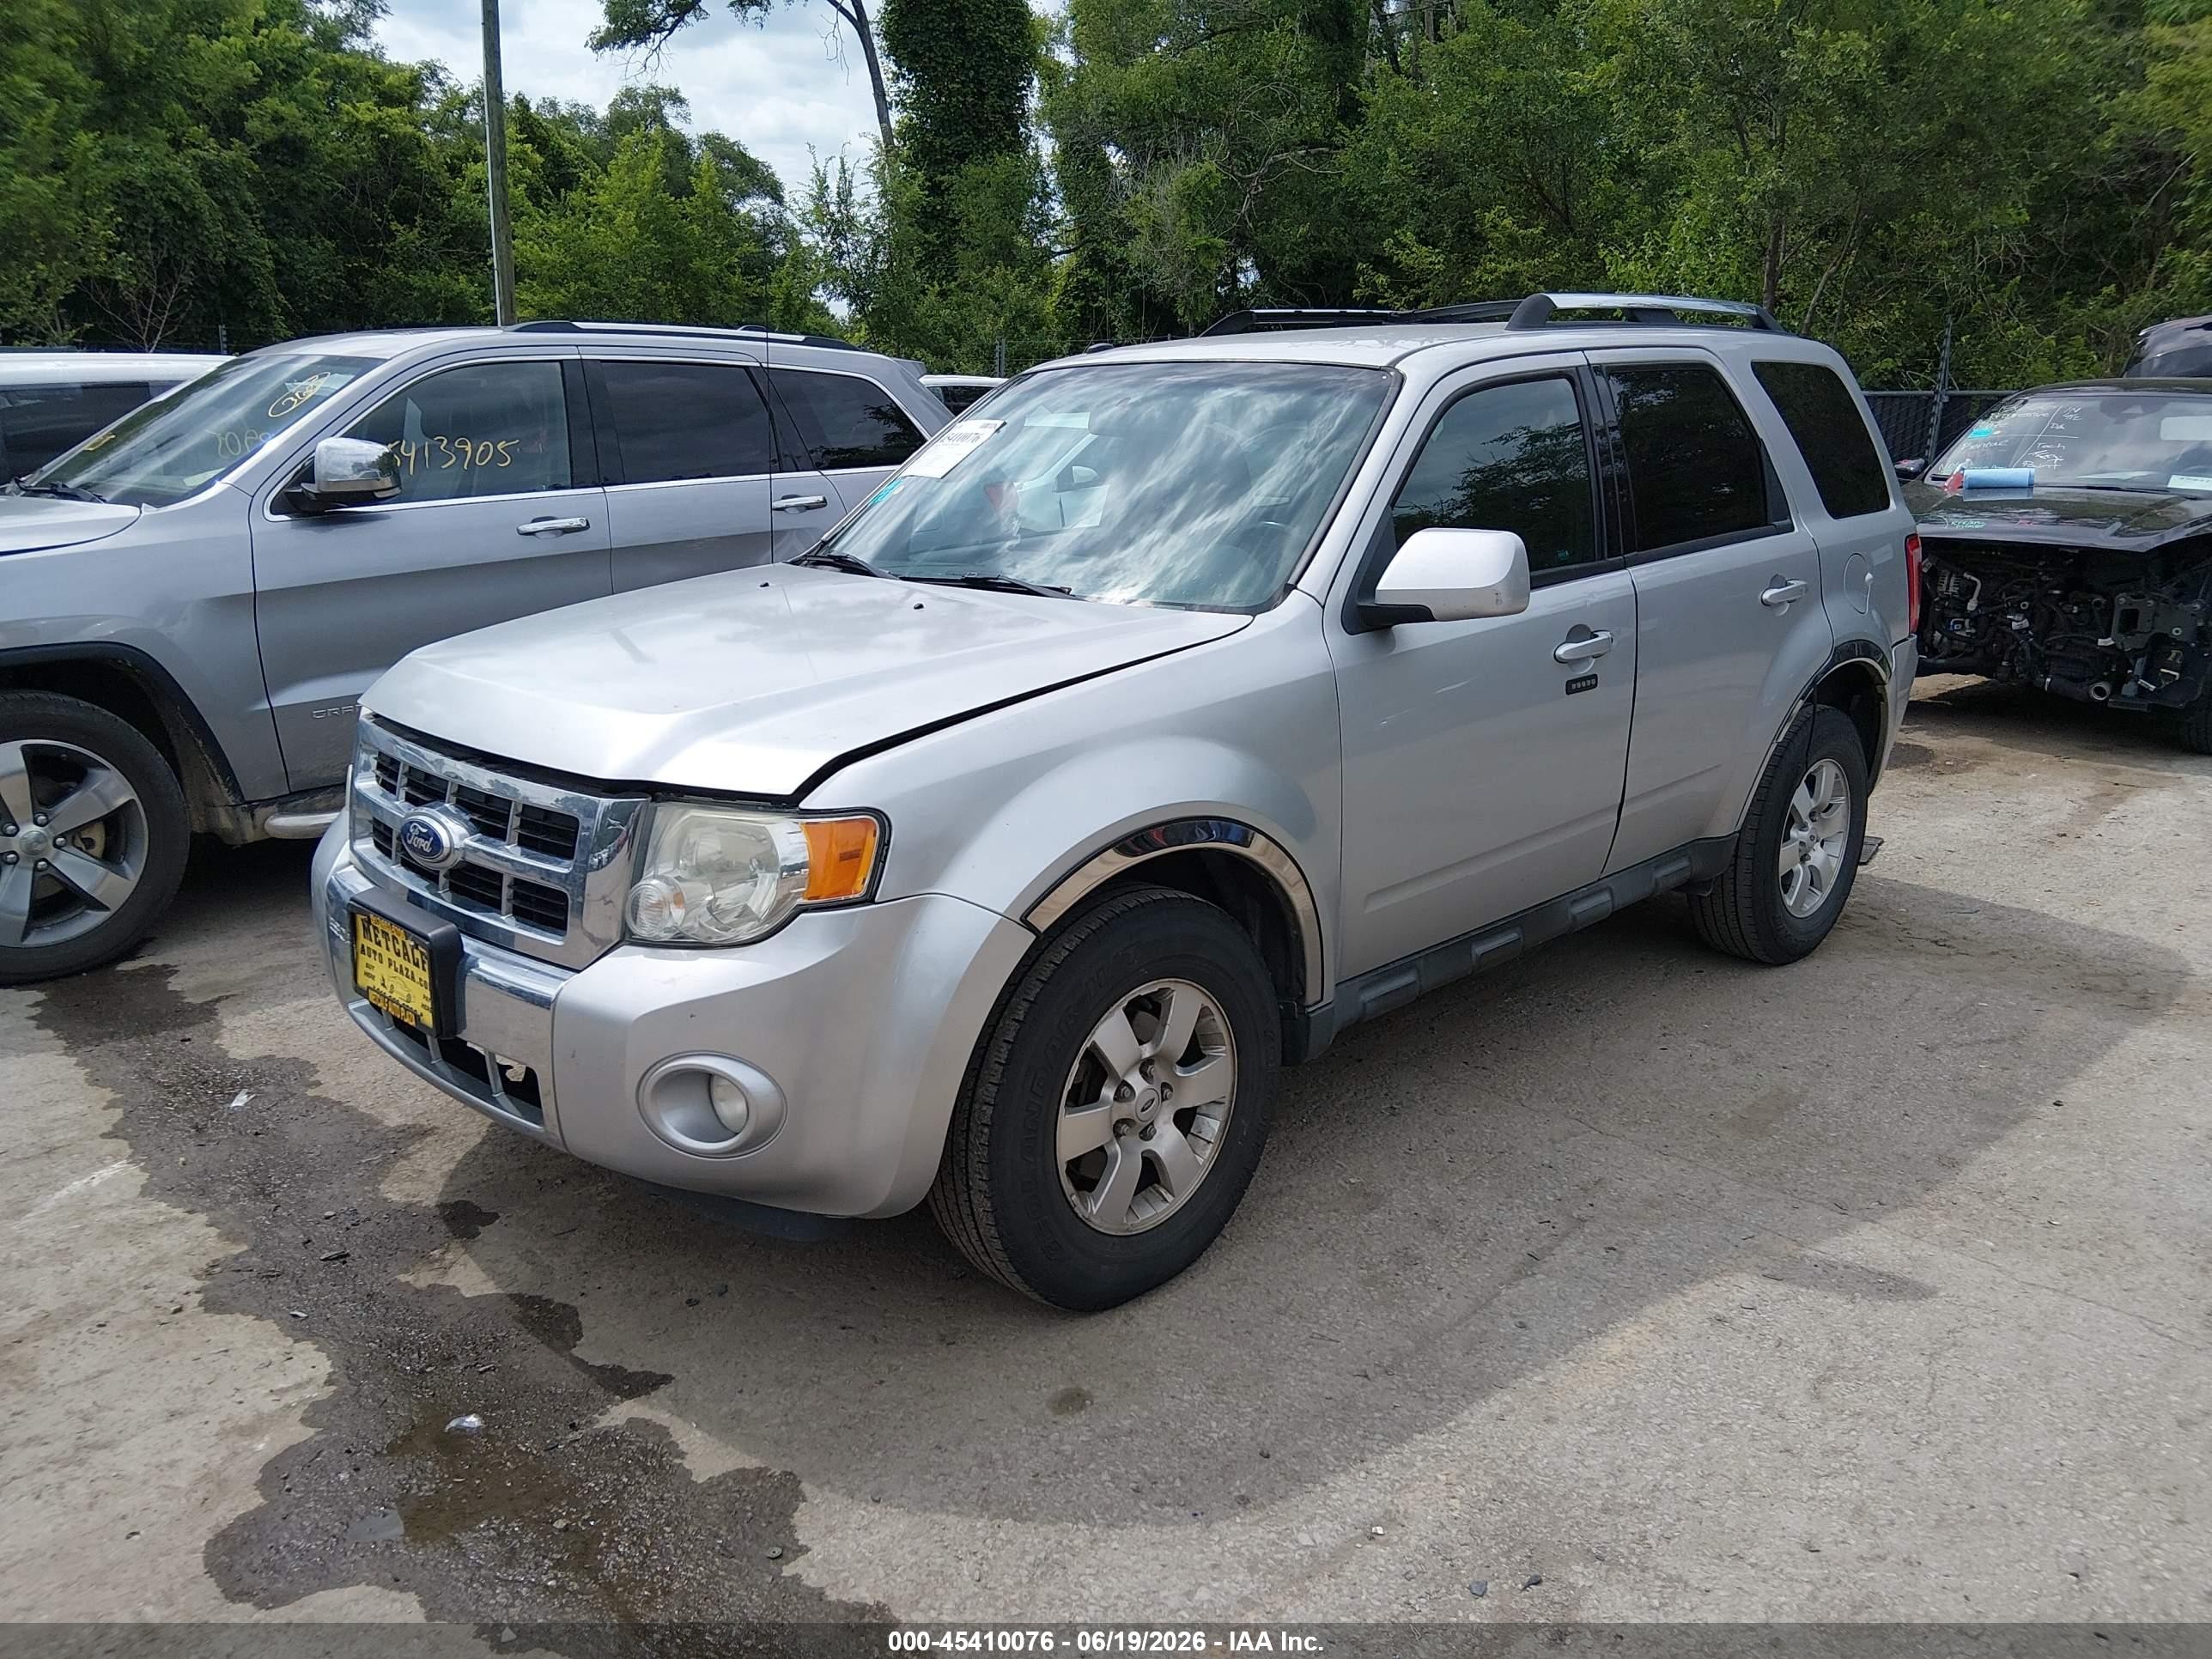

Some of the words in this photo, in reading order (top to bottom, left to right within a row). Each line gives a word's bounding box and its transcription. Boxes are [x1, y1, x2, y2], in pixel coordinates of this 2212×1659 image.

[387, 435, 520, 475] 5413905
[406, 822, 434, 853] Ford
[360, 943, 384, 964] AUTO
[361, 917, 428, 972] METCALF
